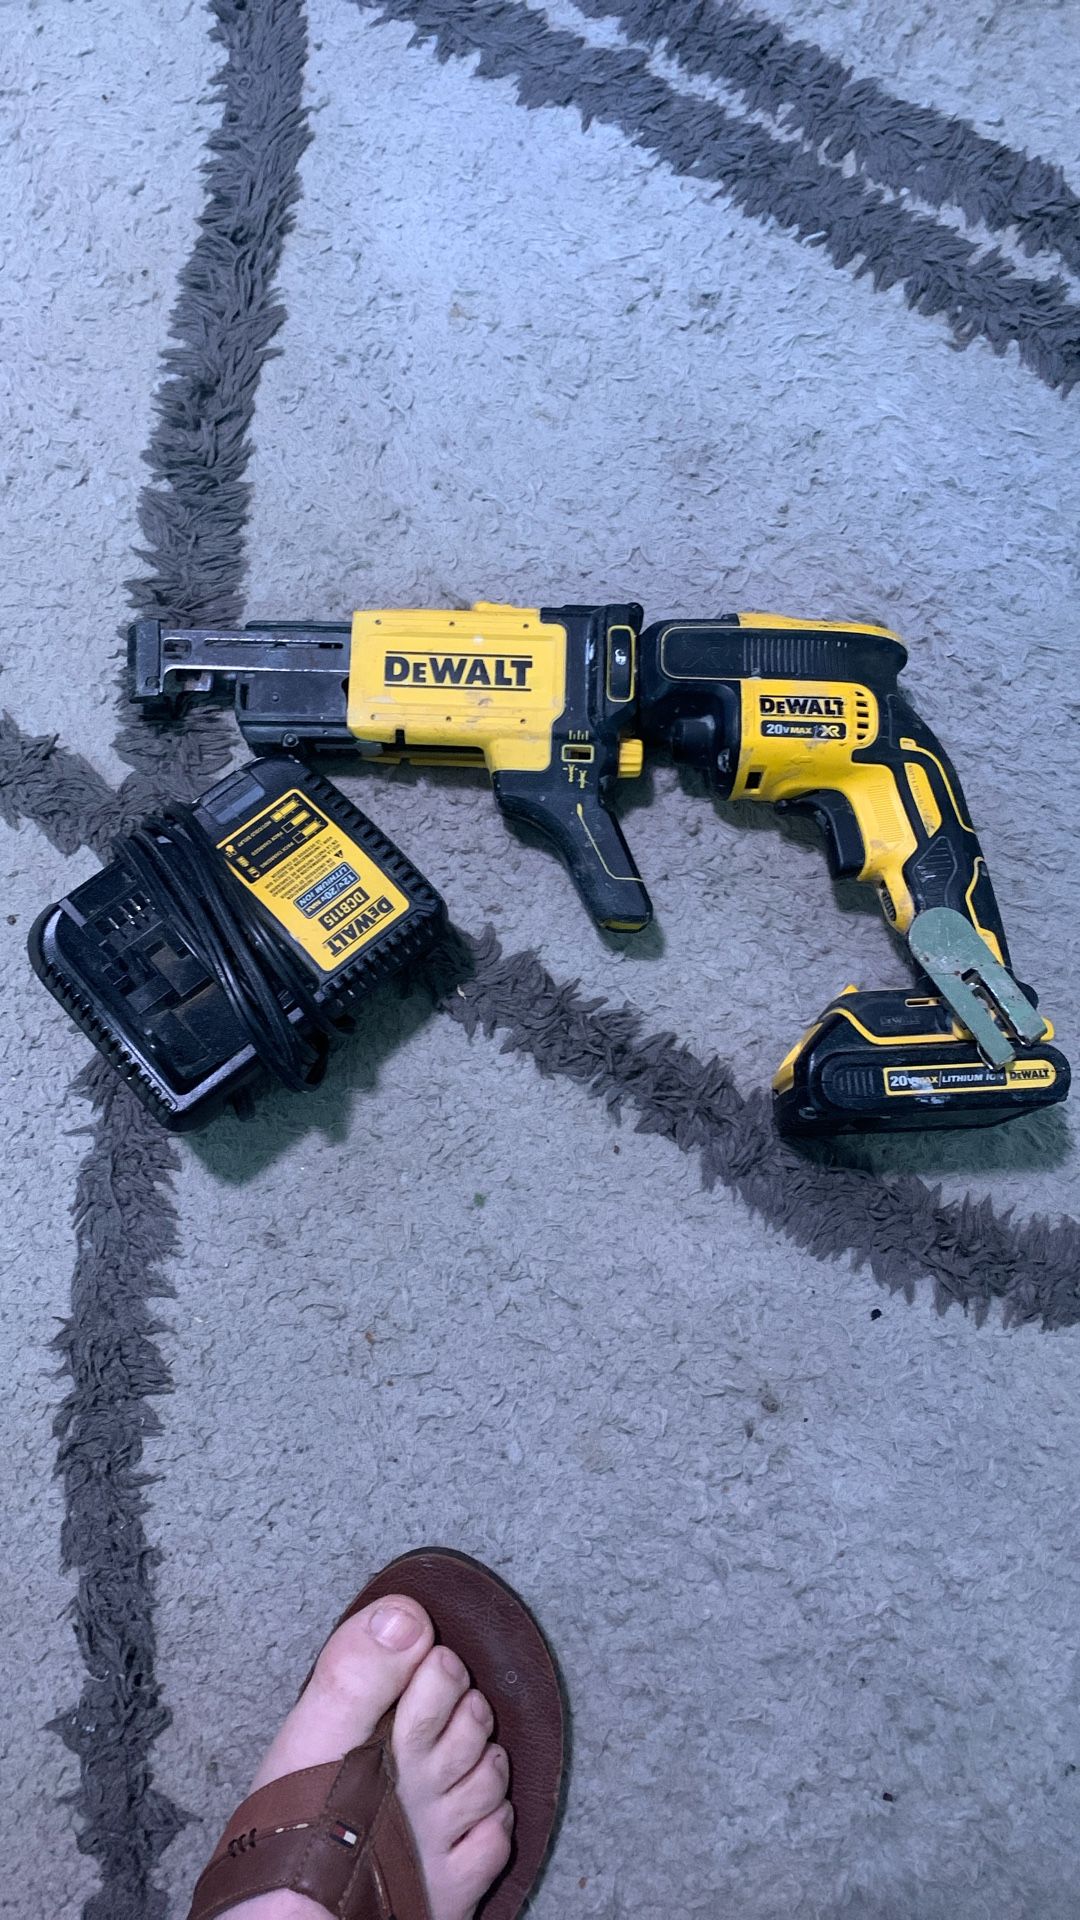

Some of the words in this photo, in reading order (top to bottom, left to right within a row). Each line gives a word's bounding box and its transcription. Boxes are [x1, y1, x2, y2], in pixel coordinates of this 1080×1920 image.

[384, 656, 533, 687] DEWALT
[760, 697, 844, 715] DEWALT
[820, 724, 841, 738] XR
[314, 866, 347, 893] LITHIUM
[299, 891, 315, 906] ION
[305, 899, 321, 913] MAX
[323, 891, 365, 926] DCB115
[327, 897, 394, 956] DEWALT
[942, 1073, 983, 1083] LITHIUM
